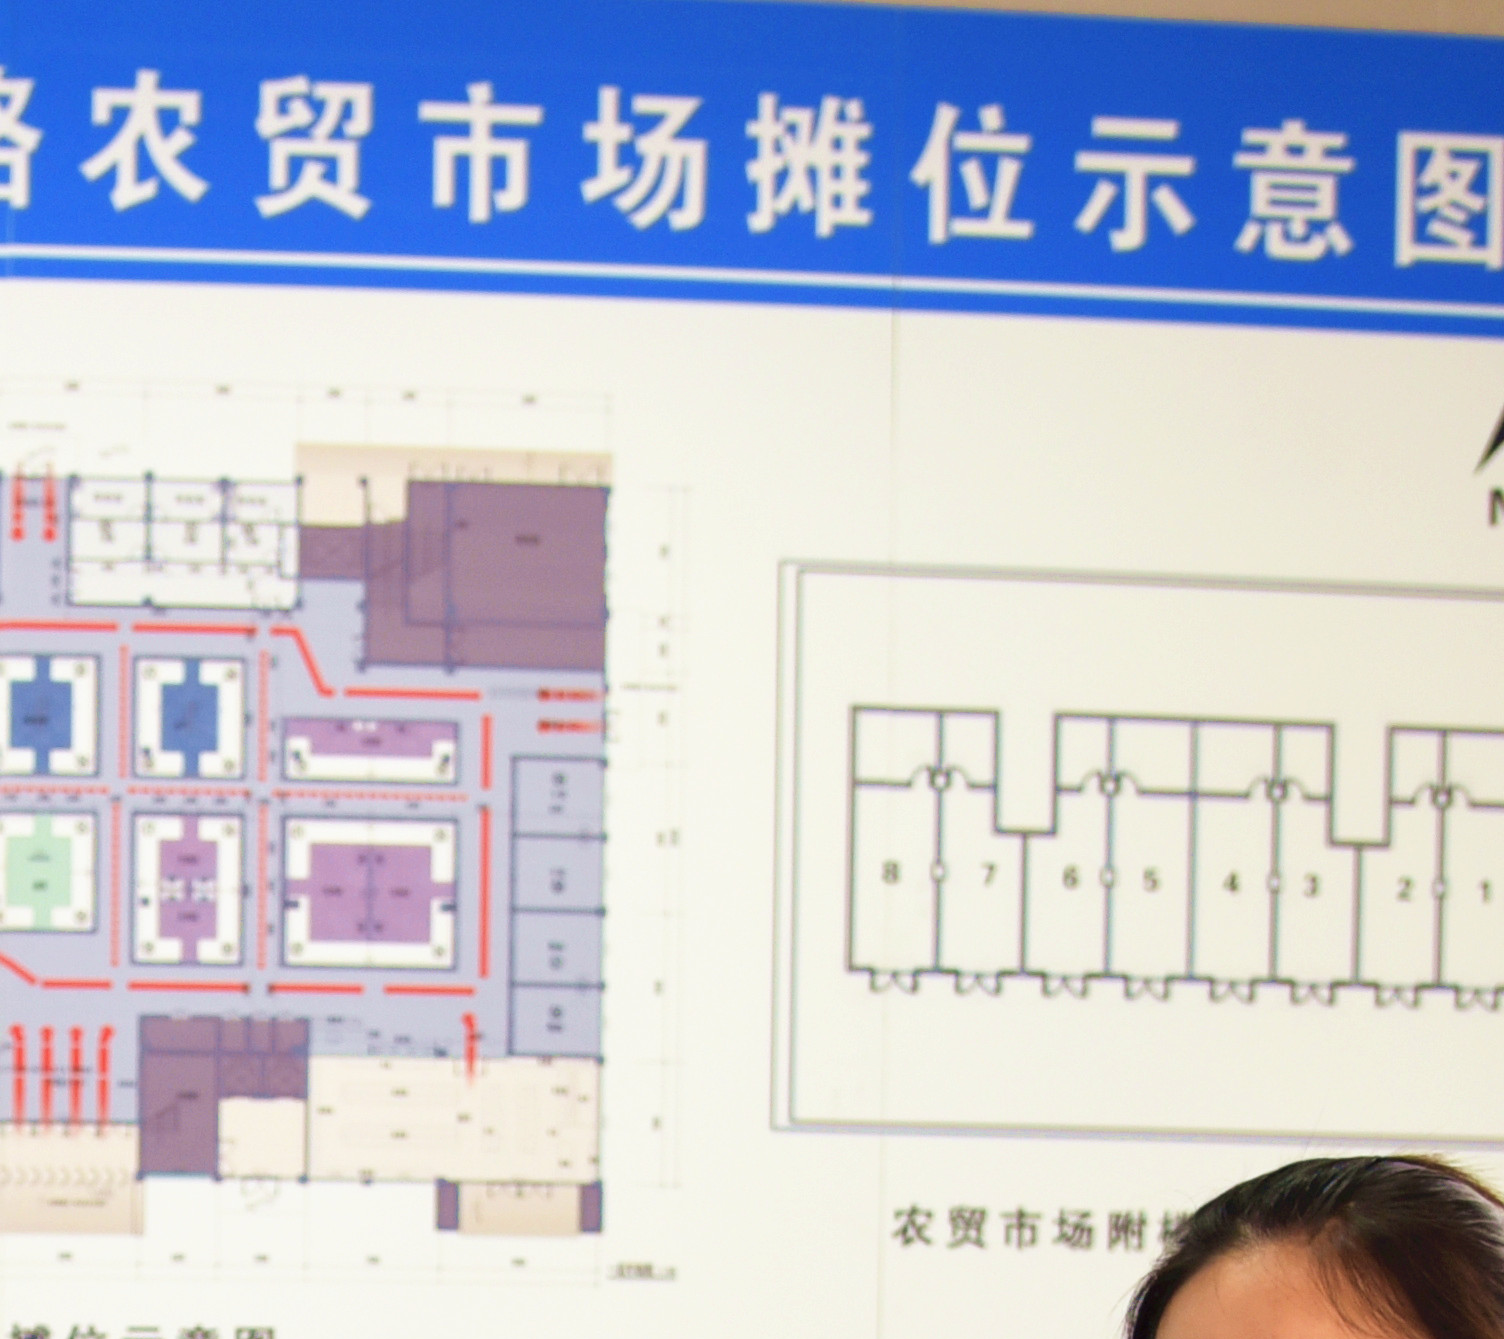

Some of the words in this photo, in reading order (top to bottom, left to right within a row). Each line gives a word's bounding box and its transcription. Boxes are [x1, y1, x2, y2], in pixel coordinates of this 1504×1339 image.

[883, 861, 898, 884] 8
[982, 864, 997, 886] 7
[1063, 866, 1079, 890] 6
[1143, 868, 1159, 891] 5
[1223, 872, 1239, 893] 4
[1304, 874, 1319, 897] 3
[1397, 879, 1413, 900] 2
[1480, 880, 1492, 902] 1
